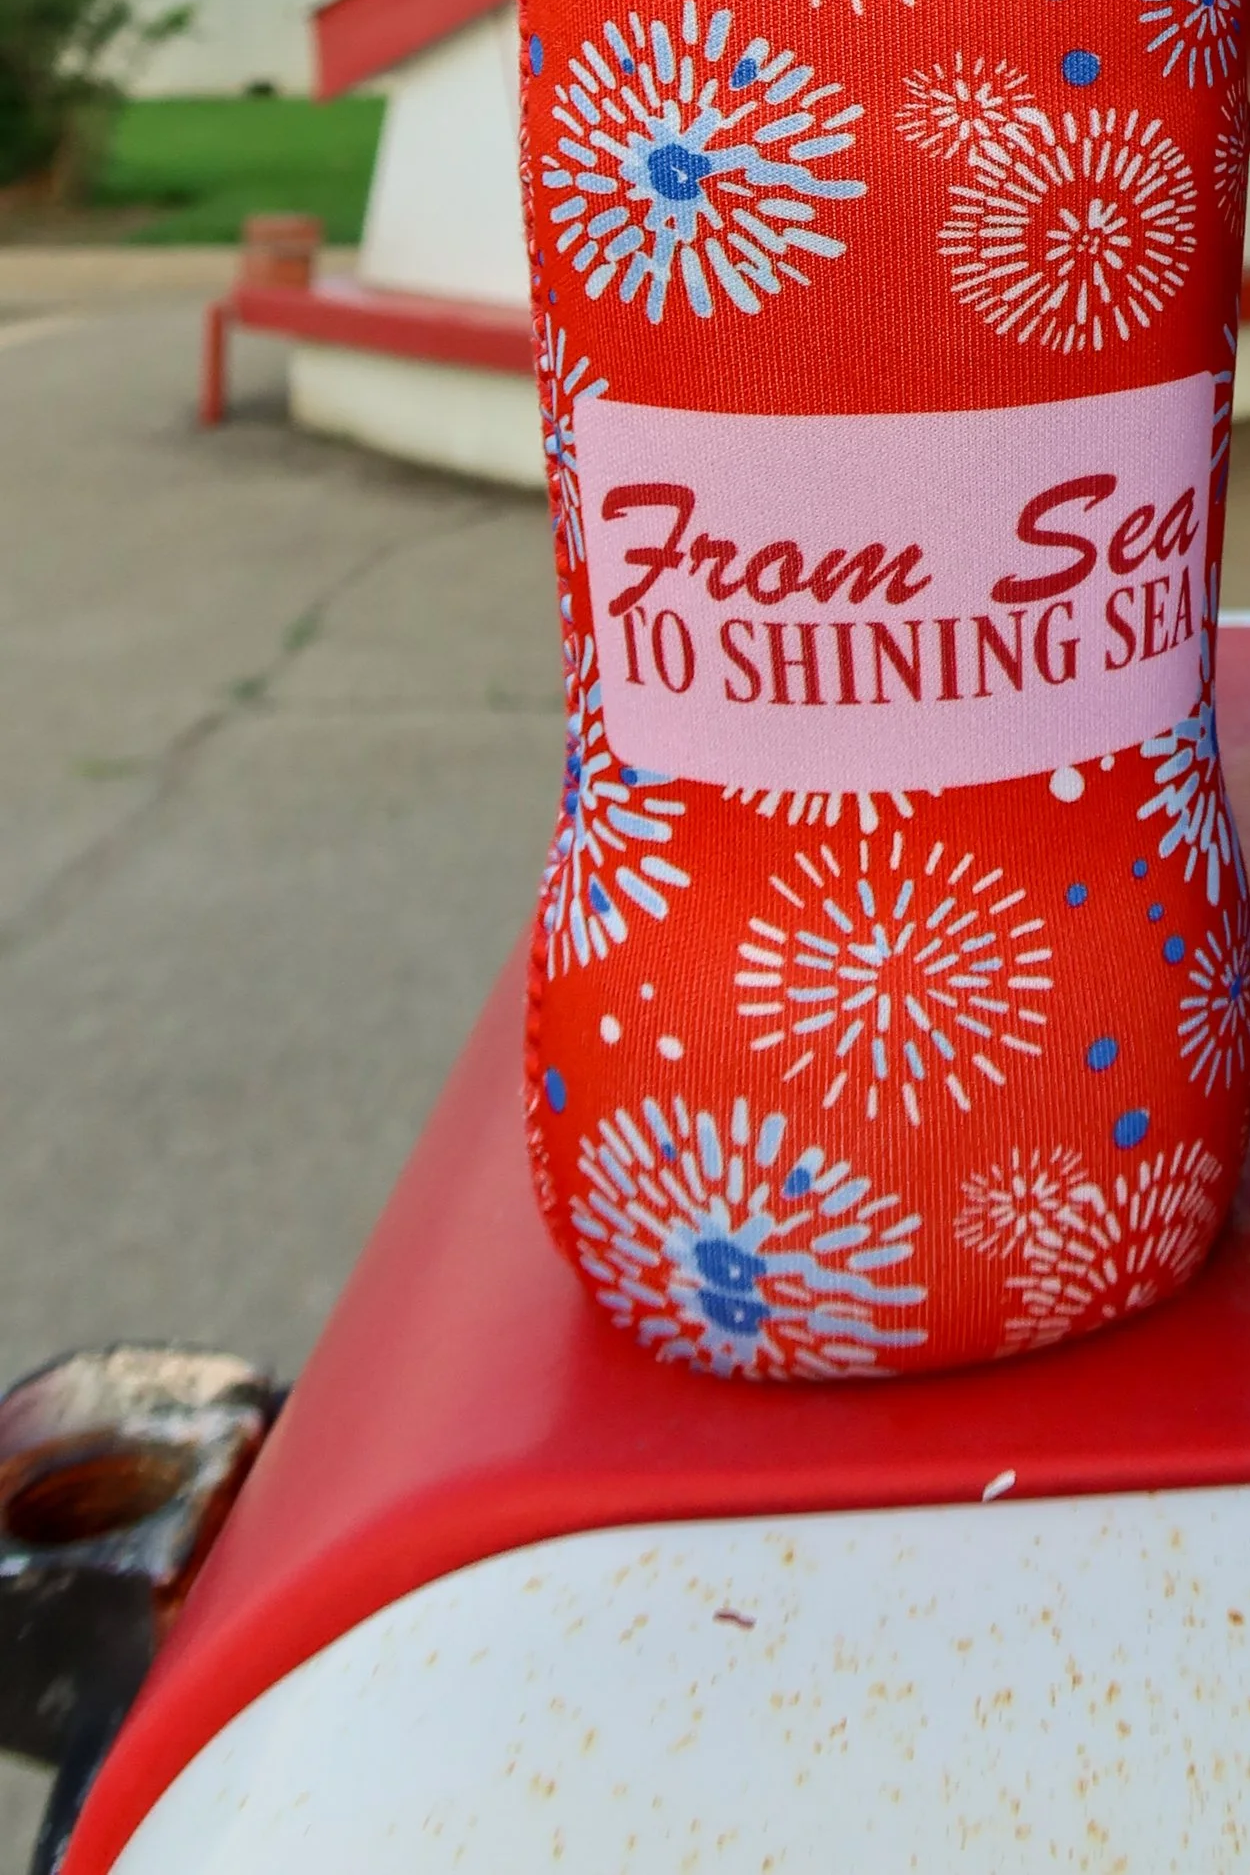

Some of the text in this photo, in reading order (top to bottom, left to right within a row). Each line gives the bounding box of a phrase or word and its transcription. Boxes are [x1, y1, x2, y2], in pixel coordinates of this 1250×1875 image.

[601, 473, 1200, 617] From Sea
[622, 565, 1196, 707] TO SHINING SEA
